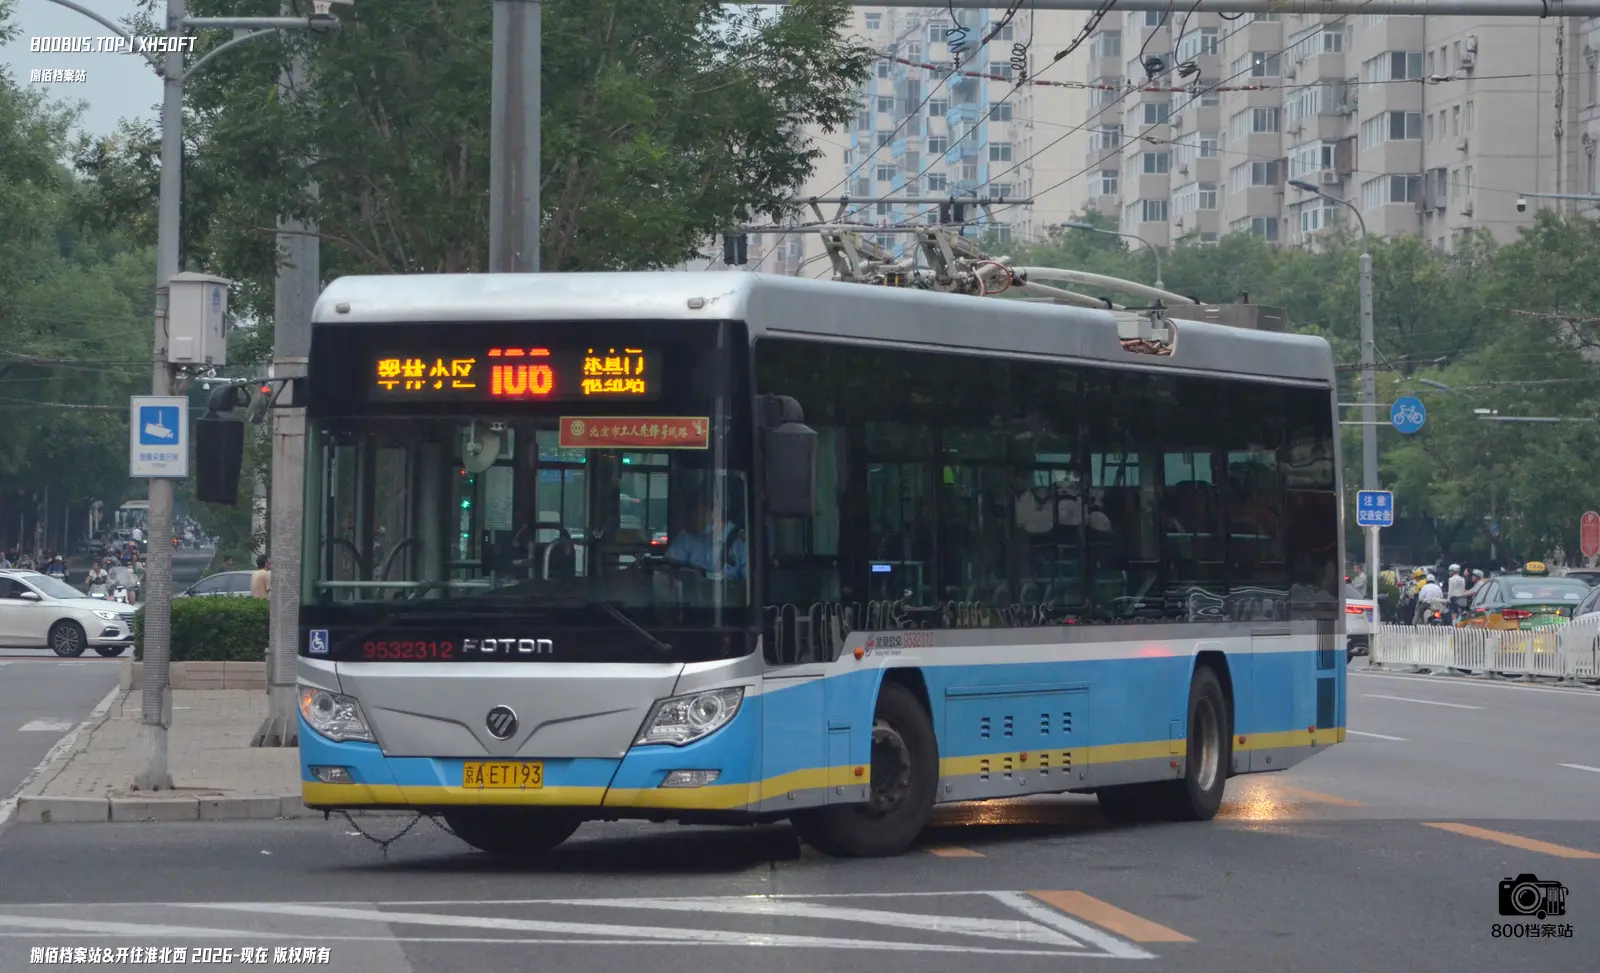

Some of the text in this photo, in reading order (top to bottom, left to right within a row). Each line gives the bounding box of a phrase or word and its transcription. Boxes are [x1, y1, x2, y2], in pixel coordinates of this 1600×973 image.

[377, 358, 476, 390] 翠林小区
[488, 348, 553, 394] 106
[588, 423, 689, 440] 北京市工人先锋号线路
[1359, 509, 1391, 521] 交通安全
[363, 641, 453, 659] 9532312
[462, 639, 553, 653] FOTON
